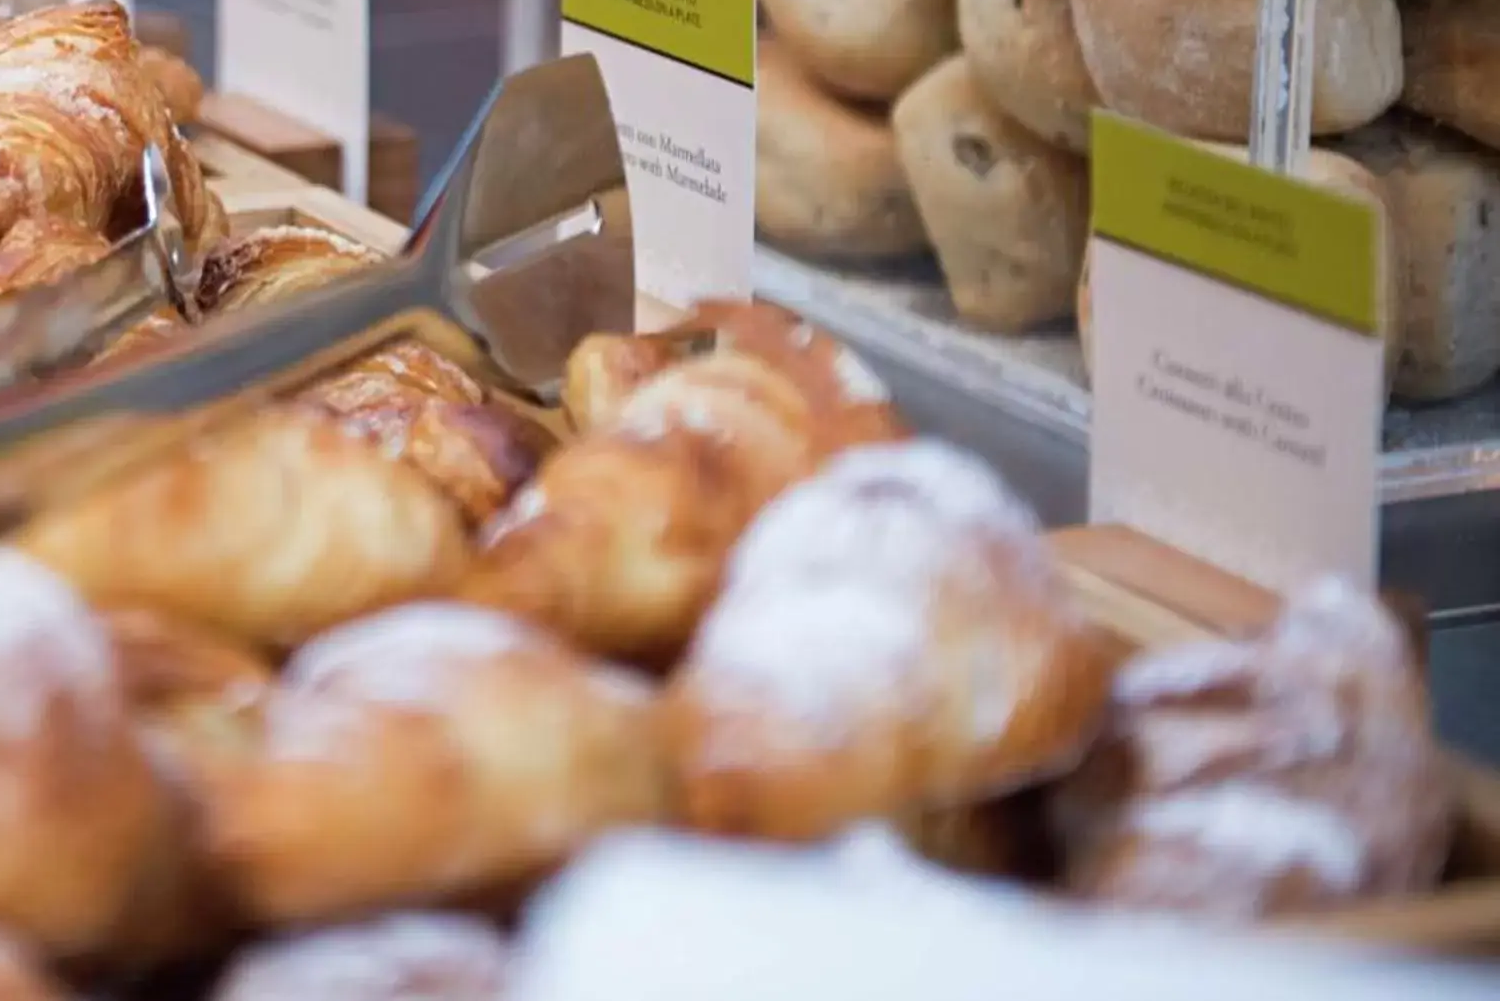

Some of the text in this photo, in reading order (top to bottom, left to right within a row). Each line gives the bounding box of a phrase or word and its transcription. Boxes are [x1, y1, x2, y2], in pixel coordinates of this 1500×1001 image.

[675, 7, 703, 29] PLATE
[660, 132, 722, 175] Marmellata
[639, 155, 663, 178] with
